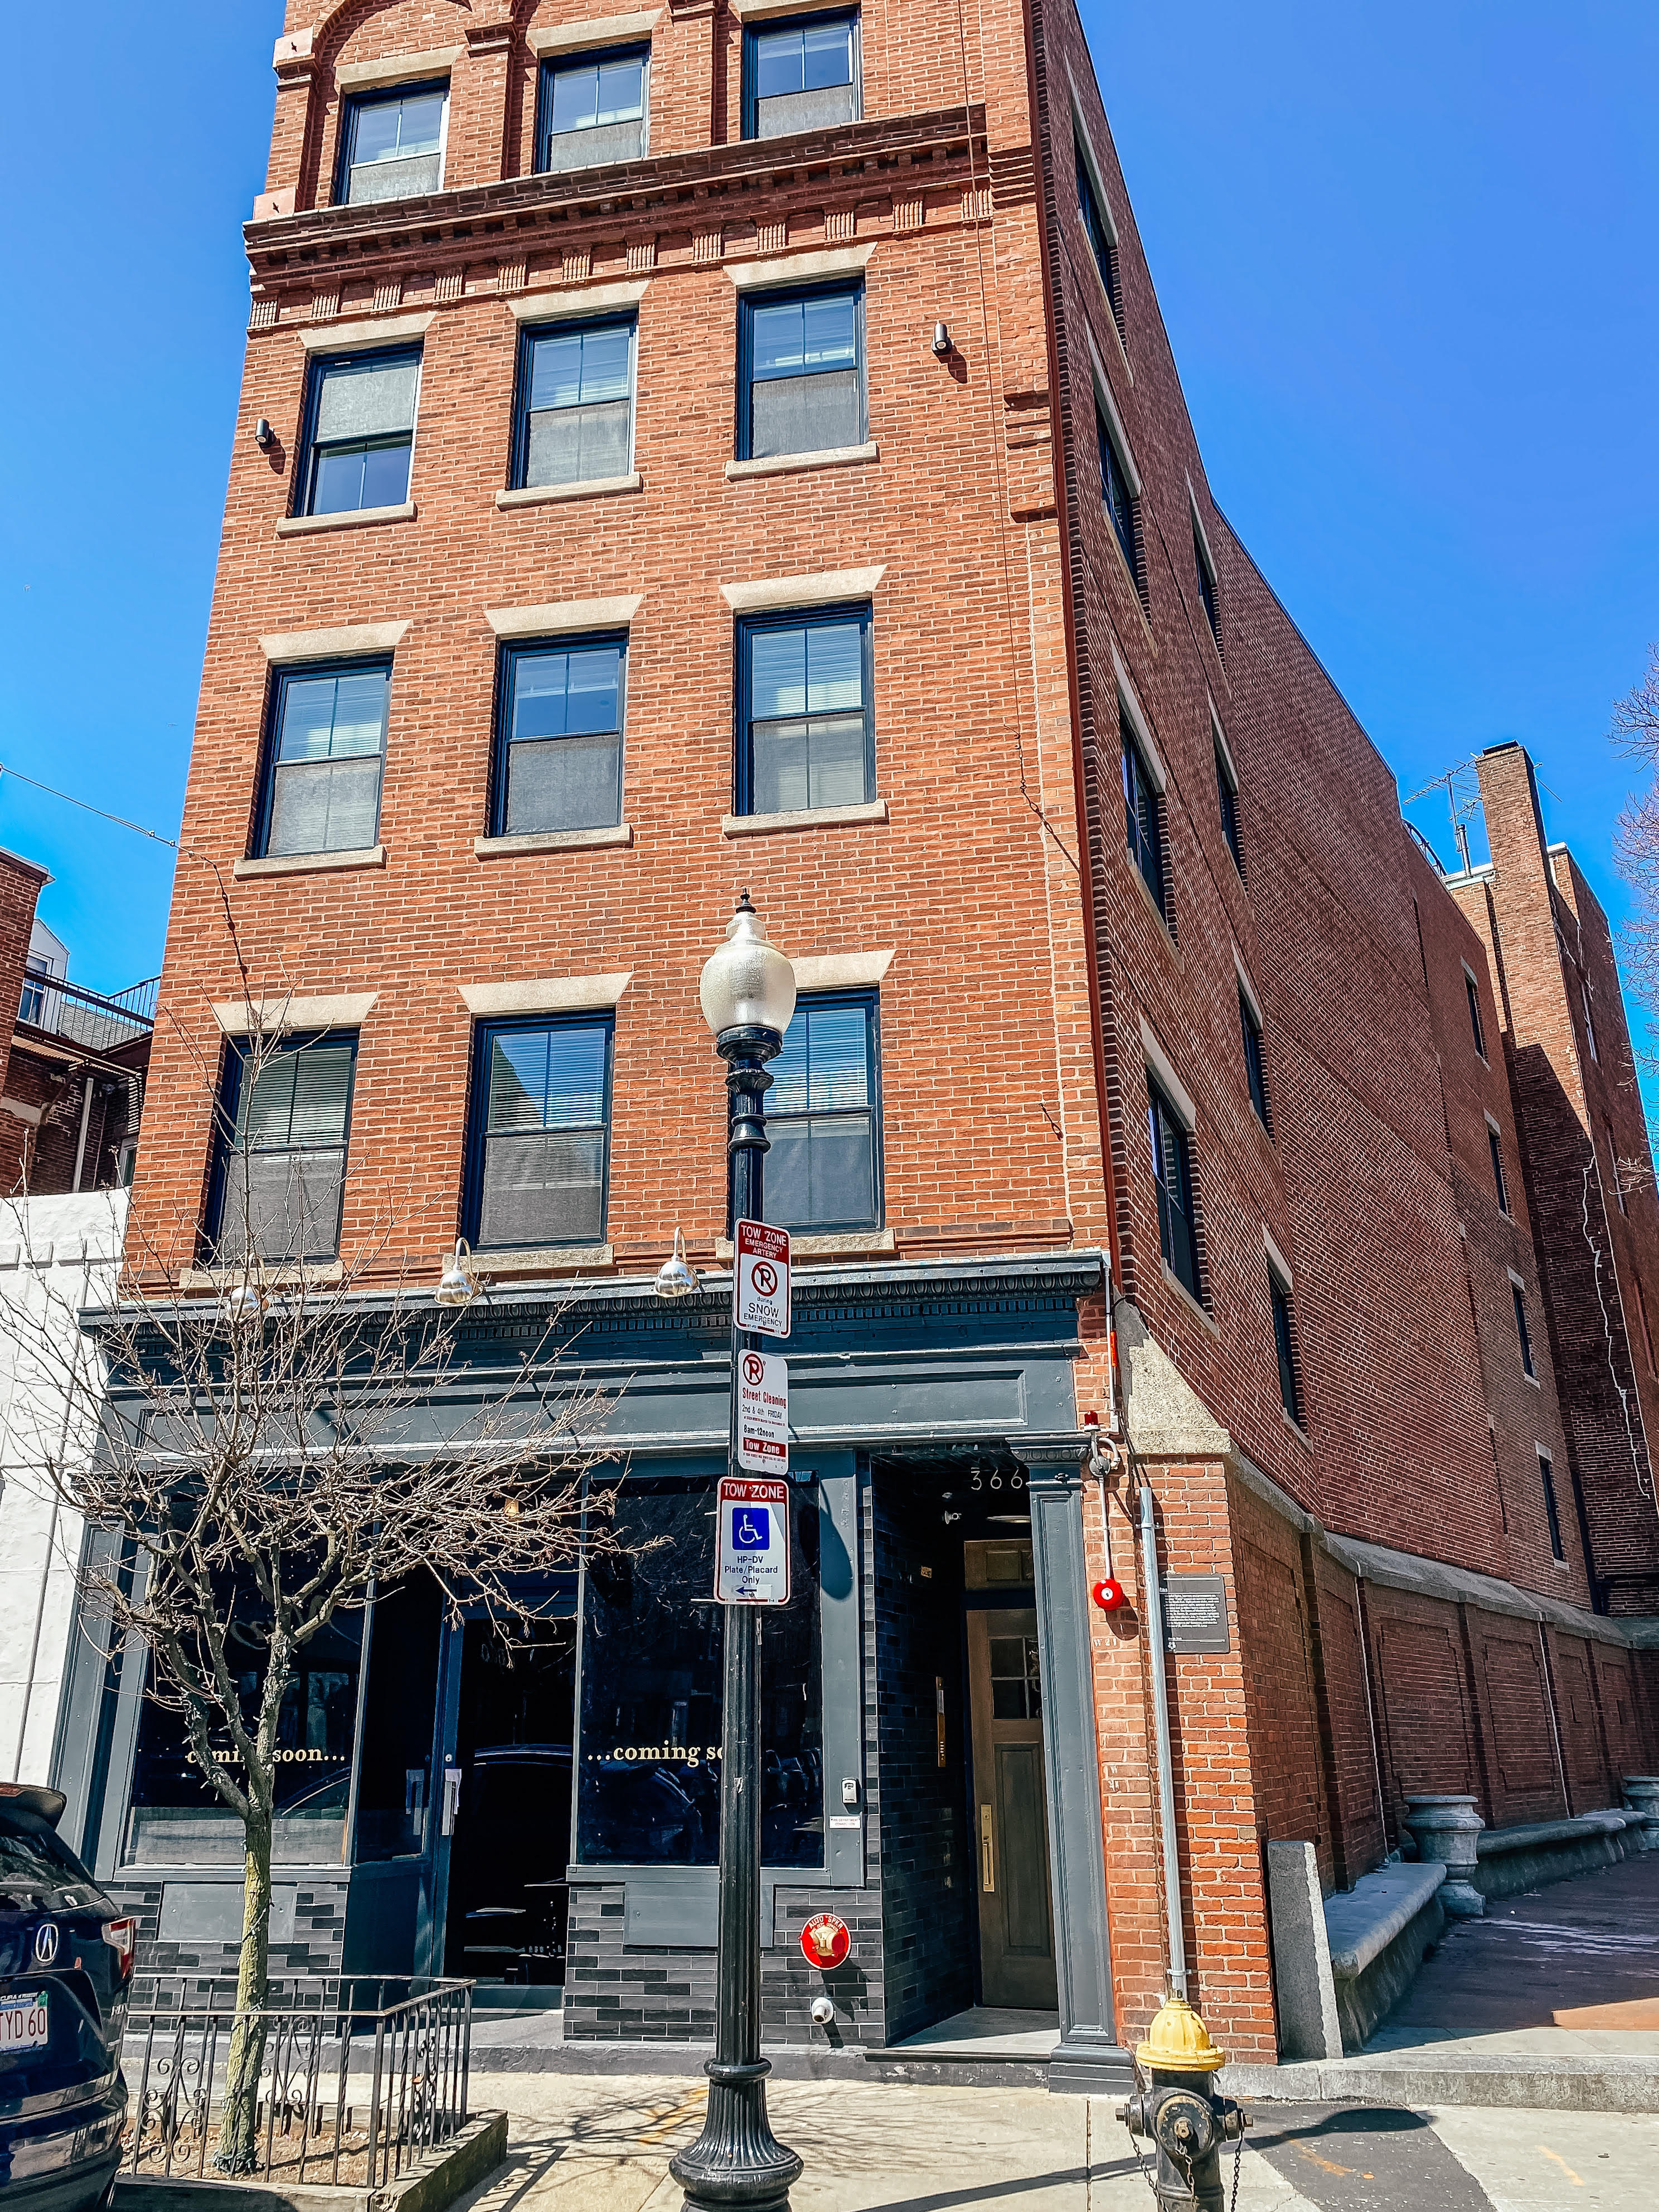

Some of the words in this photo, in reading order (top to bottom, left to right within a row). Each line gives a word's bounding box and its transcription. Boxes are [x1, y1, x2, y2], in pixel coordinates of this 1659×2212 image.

[741, 1225, 761, 1239] TOW
[765, 1230, 787, 1246] ZONE
[745, 1238, 783, 1253] EMERGENCY
[753, 1247, 777, 1259] ARTERY
[756, 1296, 773, 1305] during
[748, 1302, 779, 1318] SNOW
[744, 1313, 782, 1327] EMERGENCY
[743, 1387, 761, 1401] Street
[763, 1391, 787, 1409] Cleaning
[742, 1404, 750, 1413] 2nd
[752, 1406, 756, 1414] &
[768, 1409, 783, 1419] FRIDAY
[744, 1424, 774, 1438] 8am-12noon
[745, 1439, 760, 1451] Tow
[762, 1442, 780, 1454] Zone
[971, 1467, 1023, 1491] 366
[724, 1483, 747, 1497] TOW
[751, 1485, 784, 1499] ZONE
[724, 1565, 778, 1574] Plate/Placard
[742, 1576, 760, 1585] Only
[808, 1915, 824, 1929] AUTO
[28, 2008, 46, 2037] 60
